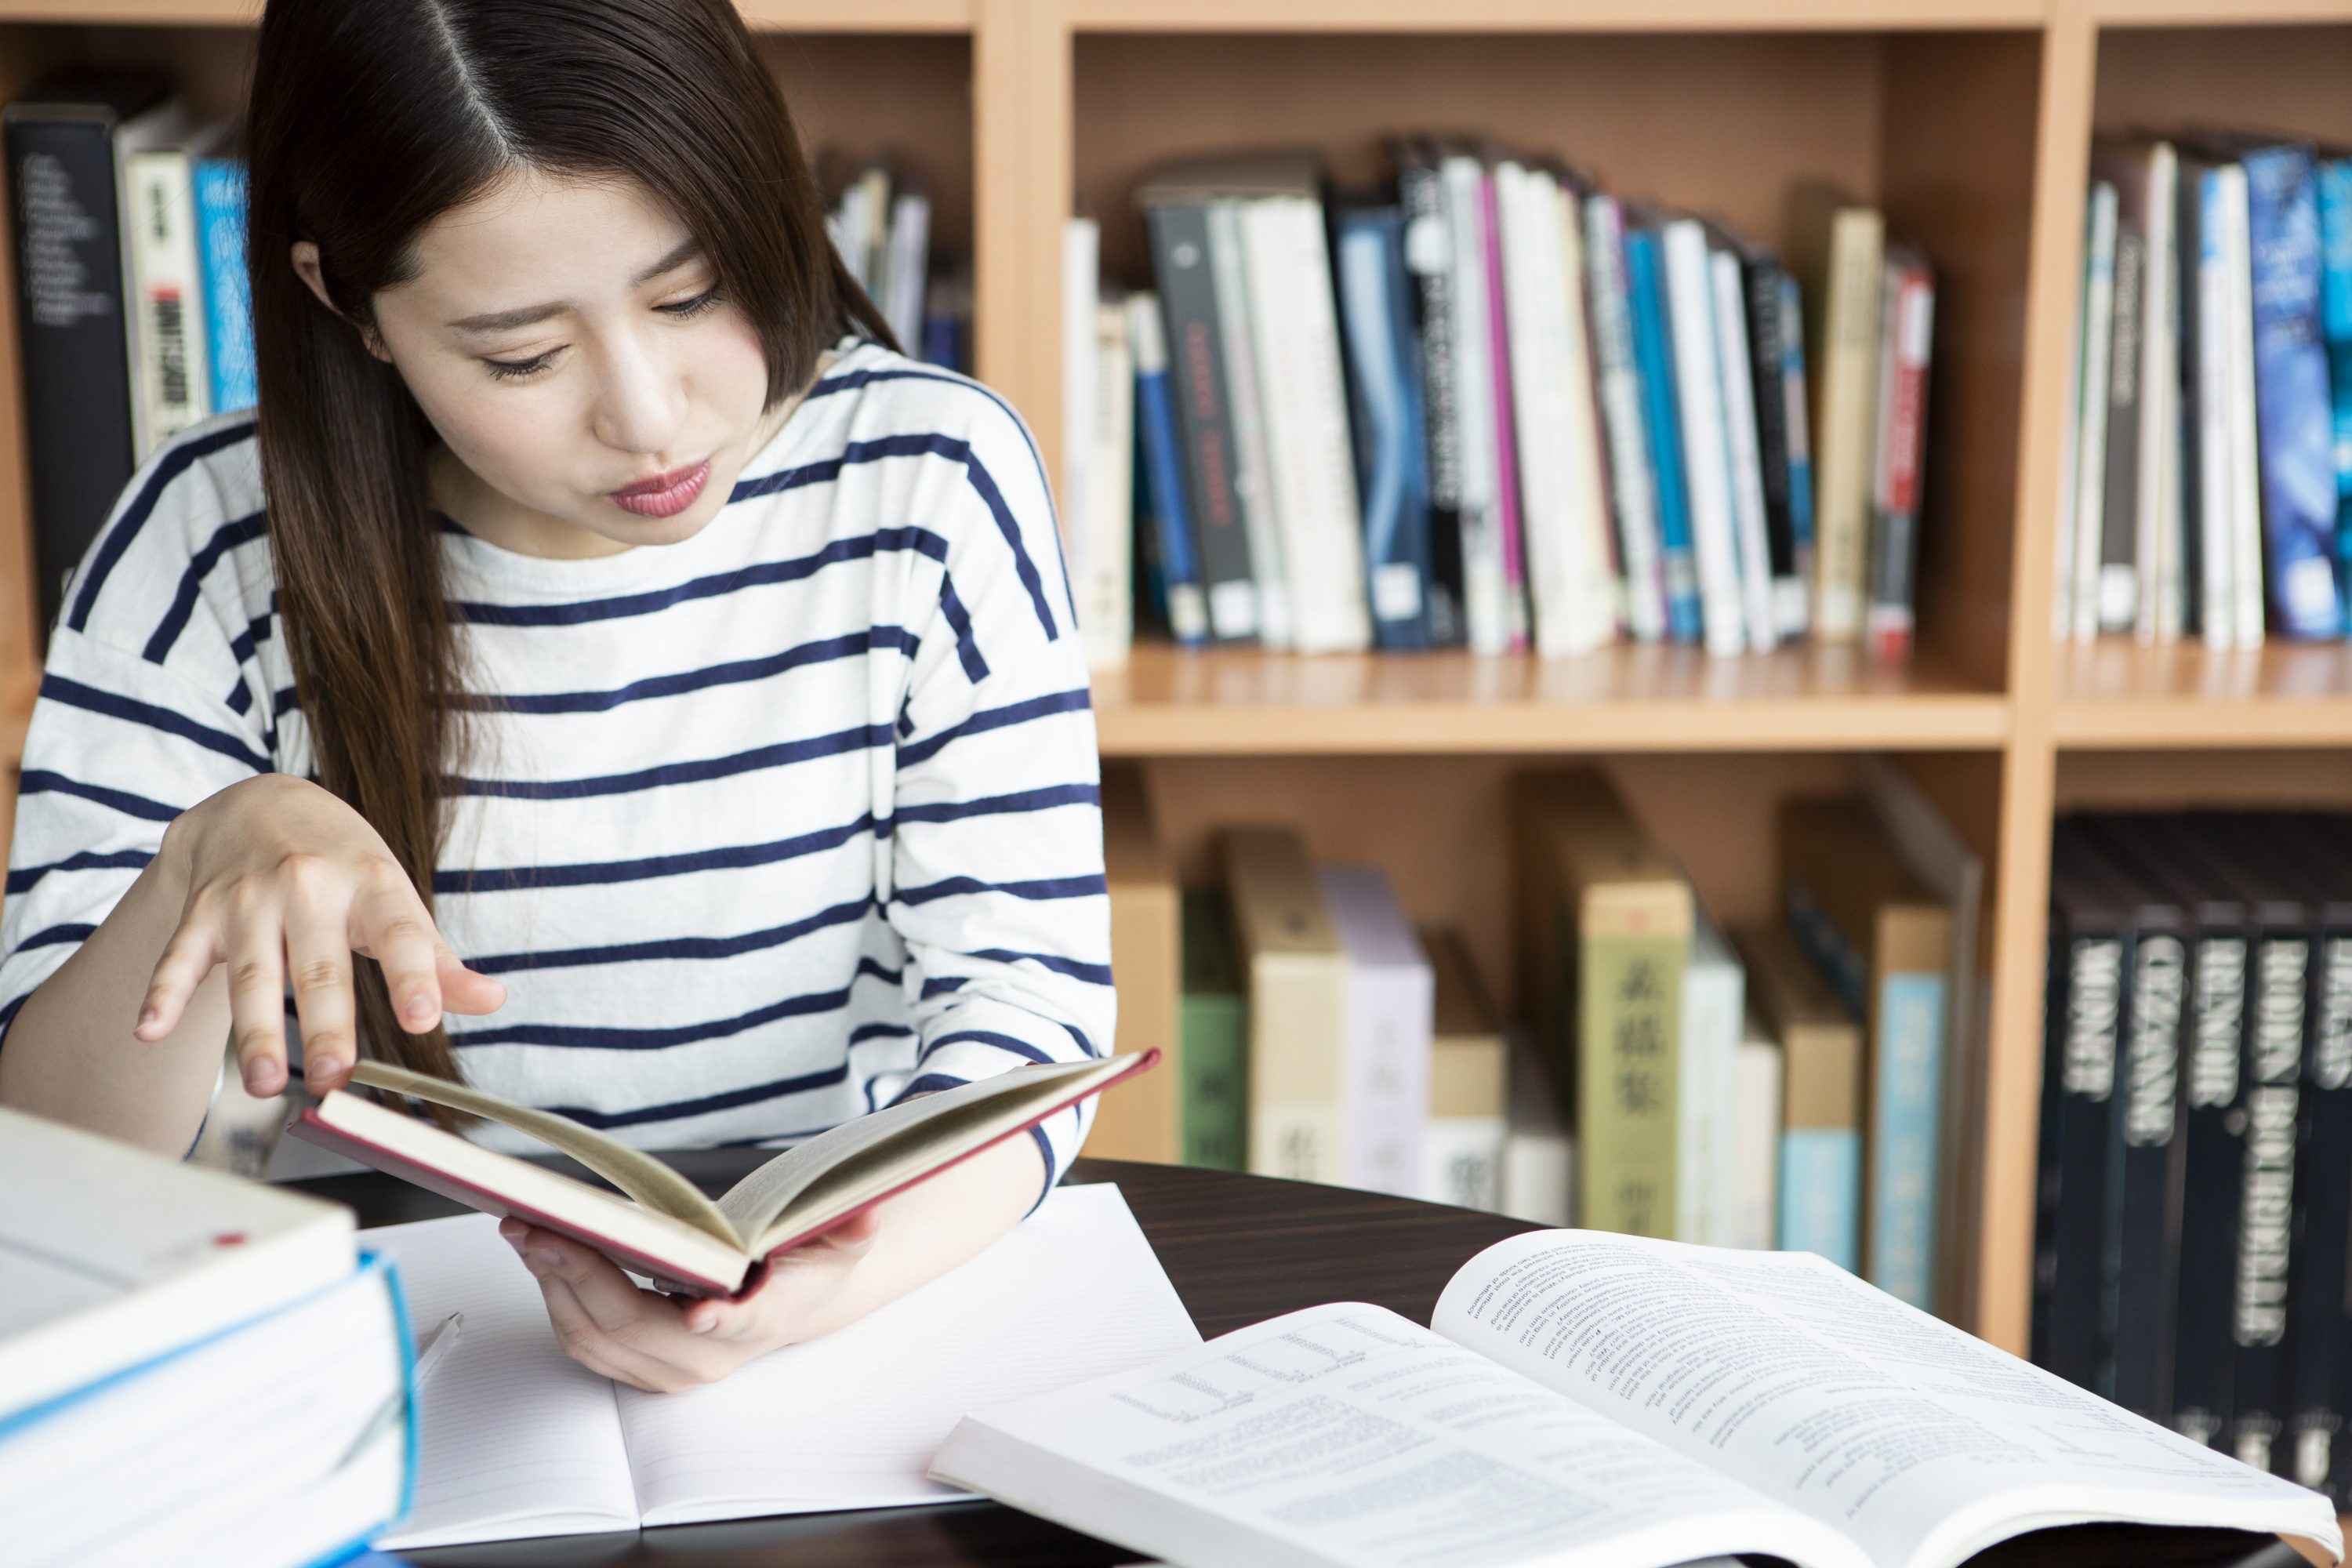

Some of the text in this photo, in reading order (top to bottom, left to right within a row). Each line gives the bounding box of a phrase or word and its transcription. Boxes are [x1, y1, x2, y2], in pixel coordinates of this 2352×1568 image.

[2062, 938, 2124, 1102] MONET
[2188, 938, 2247, 1109] RENOIR
[2234, 938, 2309, 1347] RODIN BOURDELLE
[1498, 1265, 1519, 1277] kinds
[1494, 1277, 1511, 1291] most
[1518, 1277, 1540, 1292] nature
[1467, 1284, 1492, 1316] efficiency
[1474, 1293, 1494, 1320] efficient
[1502, 1298, 1513, 1309] the
[1502, 1290, 1532, 1320] conditions
[1541, 1288, 1577, 1315] competitive
[1556, 1293, 1582, 1310] industry
[1529, 1315, 1542, 1328] firm
[1557, 1302, 1586, 1326] industry?
[1572, 1308, 1602, 1330] between
[1519, 1329, 1530, 1344] into
[1556, 1326, 1567, 1337] the
[1563, 1330, 1574, 1341] the
[1569, 1316, 1607, 1352] competition?
[1582, 1335, 1594, 1347] rule
[1610, 1334, 1624, 1347] run?
[1543, 1338, 1557, 1356] short
[1549, 1341, 1563, 1359] short
[1588, 1329, 1619, 1357] negative?
[1566, 1348, 1582, 1369] mean
[1596, 1348, 1610, 1360] Will
[1596, 1351, 1615, 1372] output
[1610, 1341, 1644, 1374] determined
[1618, 1348, 1649, 1376] individual
[1607, 1376, 1621, 1391] firm
[1619, 1377, 1634, 1397] firm?
[1626, 1381, 1641, 1400] short
